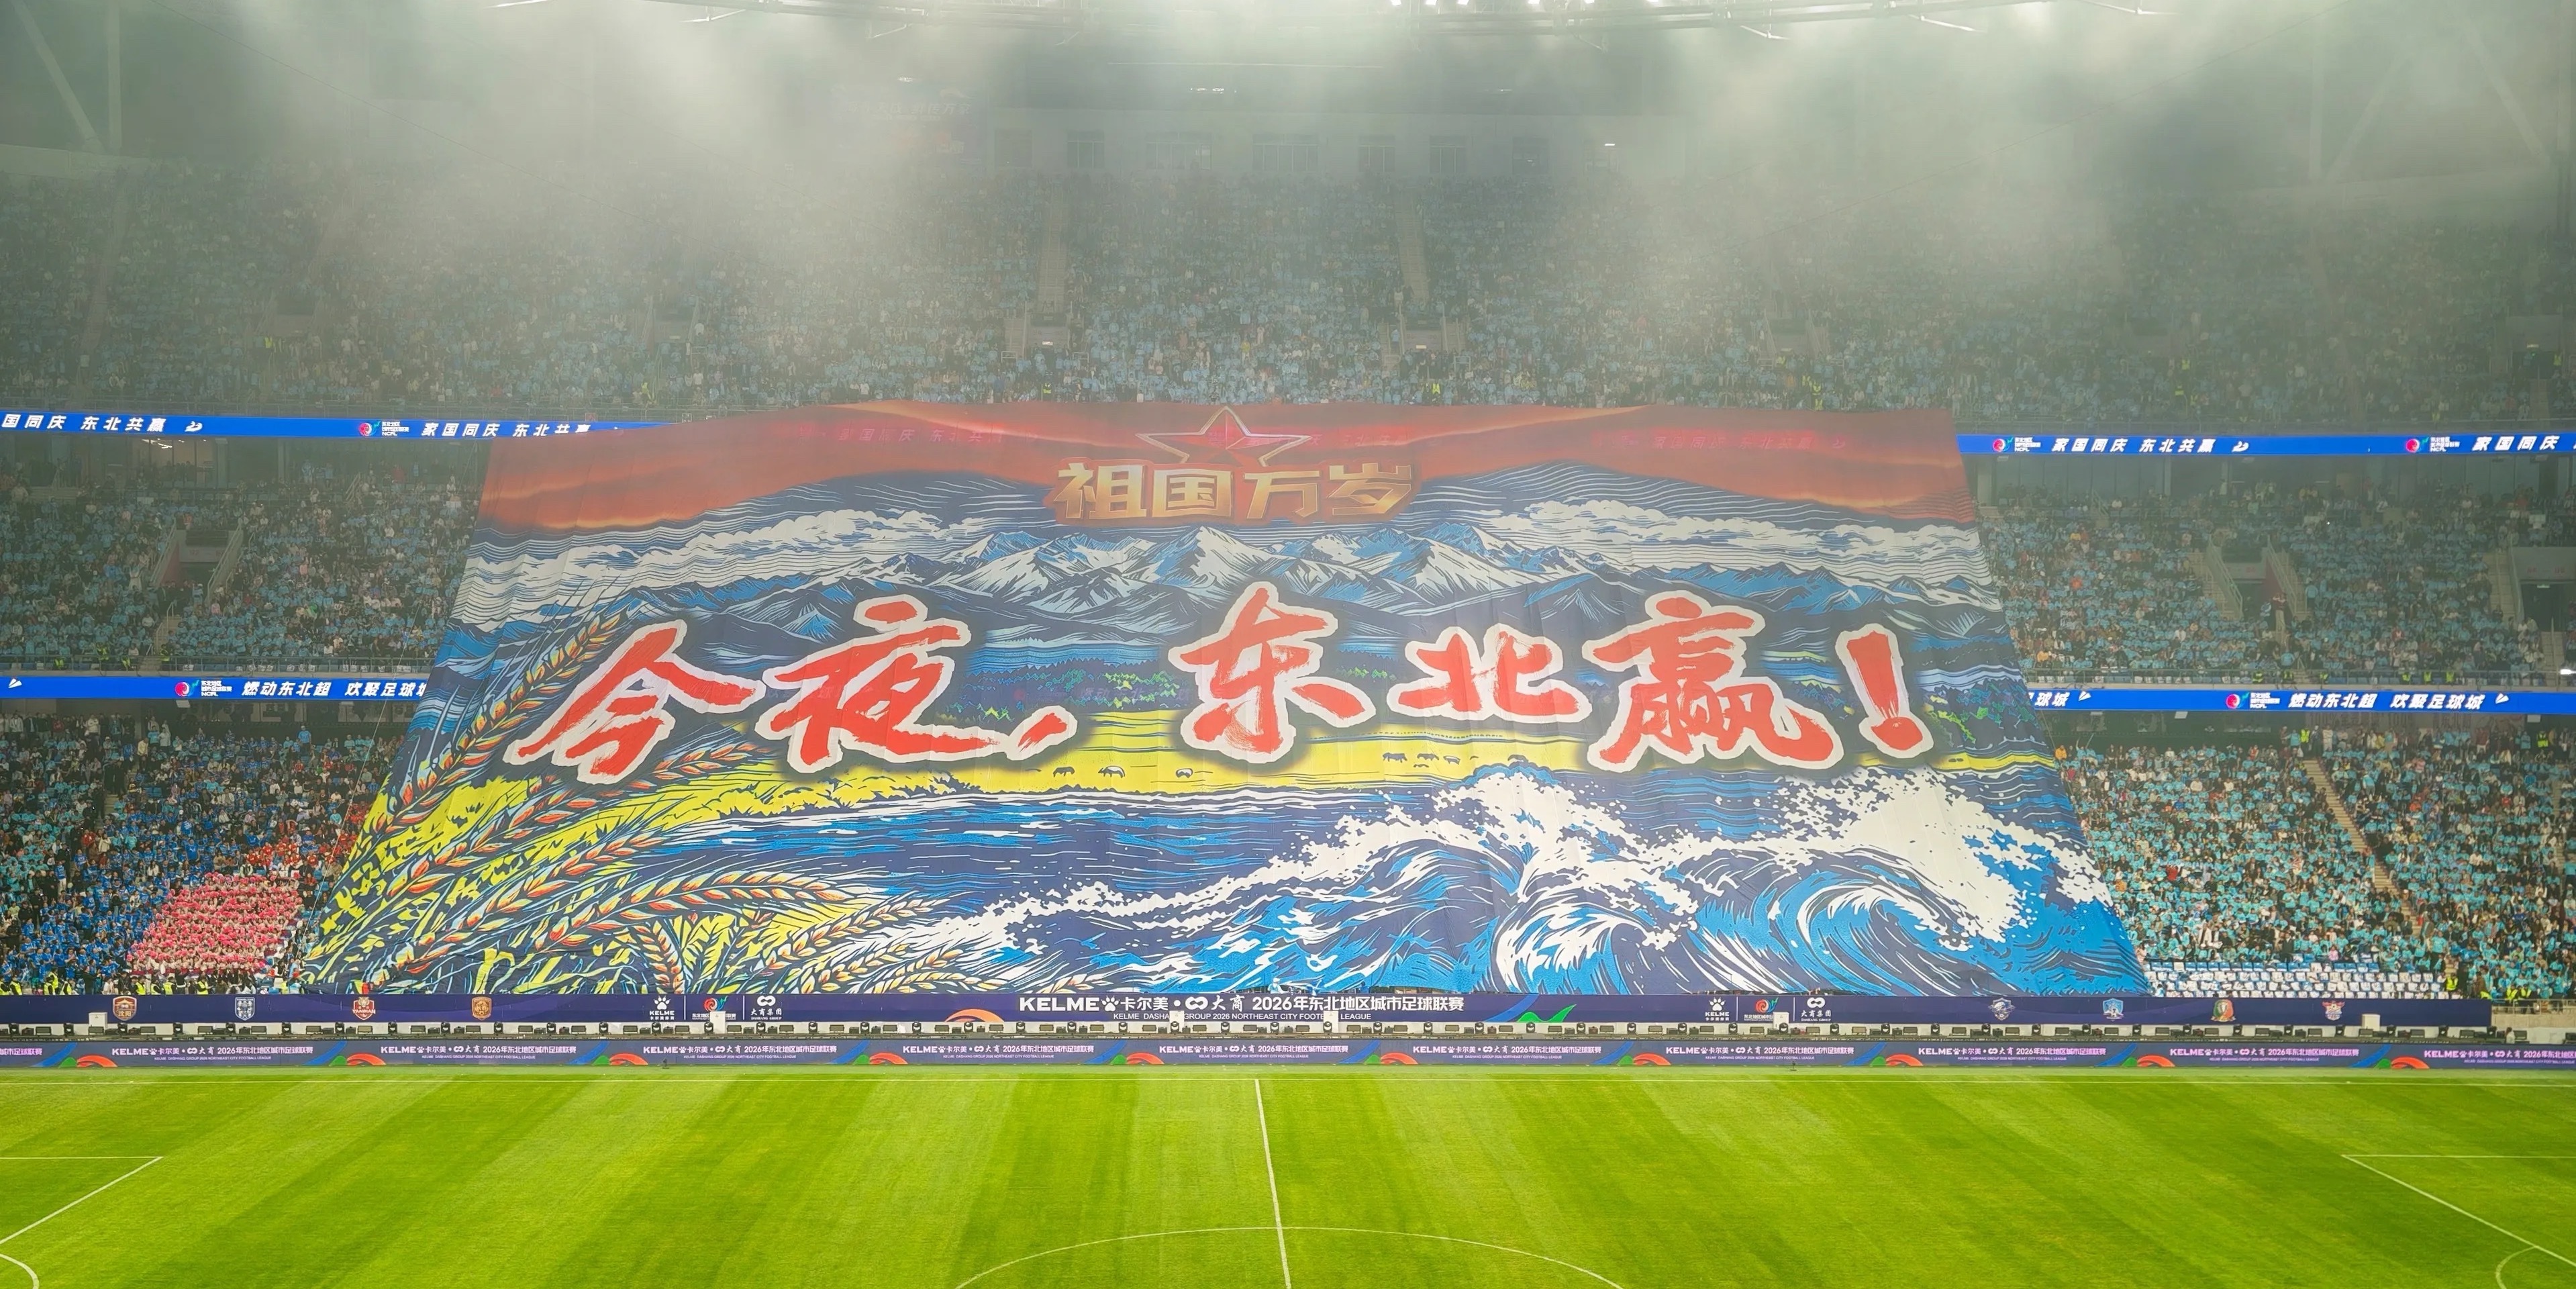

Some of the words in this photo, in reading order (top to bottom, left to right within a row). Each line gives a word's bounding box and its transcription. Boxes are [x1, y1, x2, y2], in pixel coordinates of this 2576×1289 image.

[1, 414, 66, 430] 国同庆
[81, 416, 166, 432] 东北共赢
[421, 422, 500, 436] 家国同庆
[2052, 438, 2128, 452] 家国同庆
[2139, 438, 2216, 452] 东北共赢
[2472, 436, 2560, 451] 家国同庆
[1053, 463, 1411, 519] 祖国万岁
[242, 681, 332, 696] 燃动东北超
[2288, 693, 2377, 708] 燃动东北超
[2390, 694, 2485, 710] 欢聚足球城
[1020, 997, 1099, 1011] KELME
[1120, 996, 1169, 1011] 卡尔美
[1211, 995, 1245, 1012] 大商
[1252, 996, 1465, 1012] 2026年东北地区城市足球联赛
[217, 1047, 313, 1055] 2026年东北地区城市足球联赛
